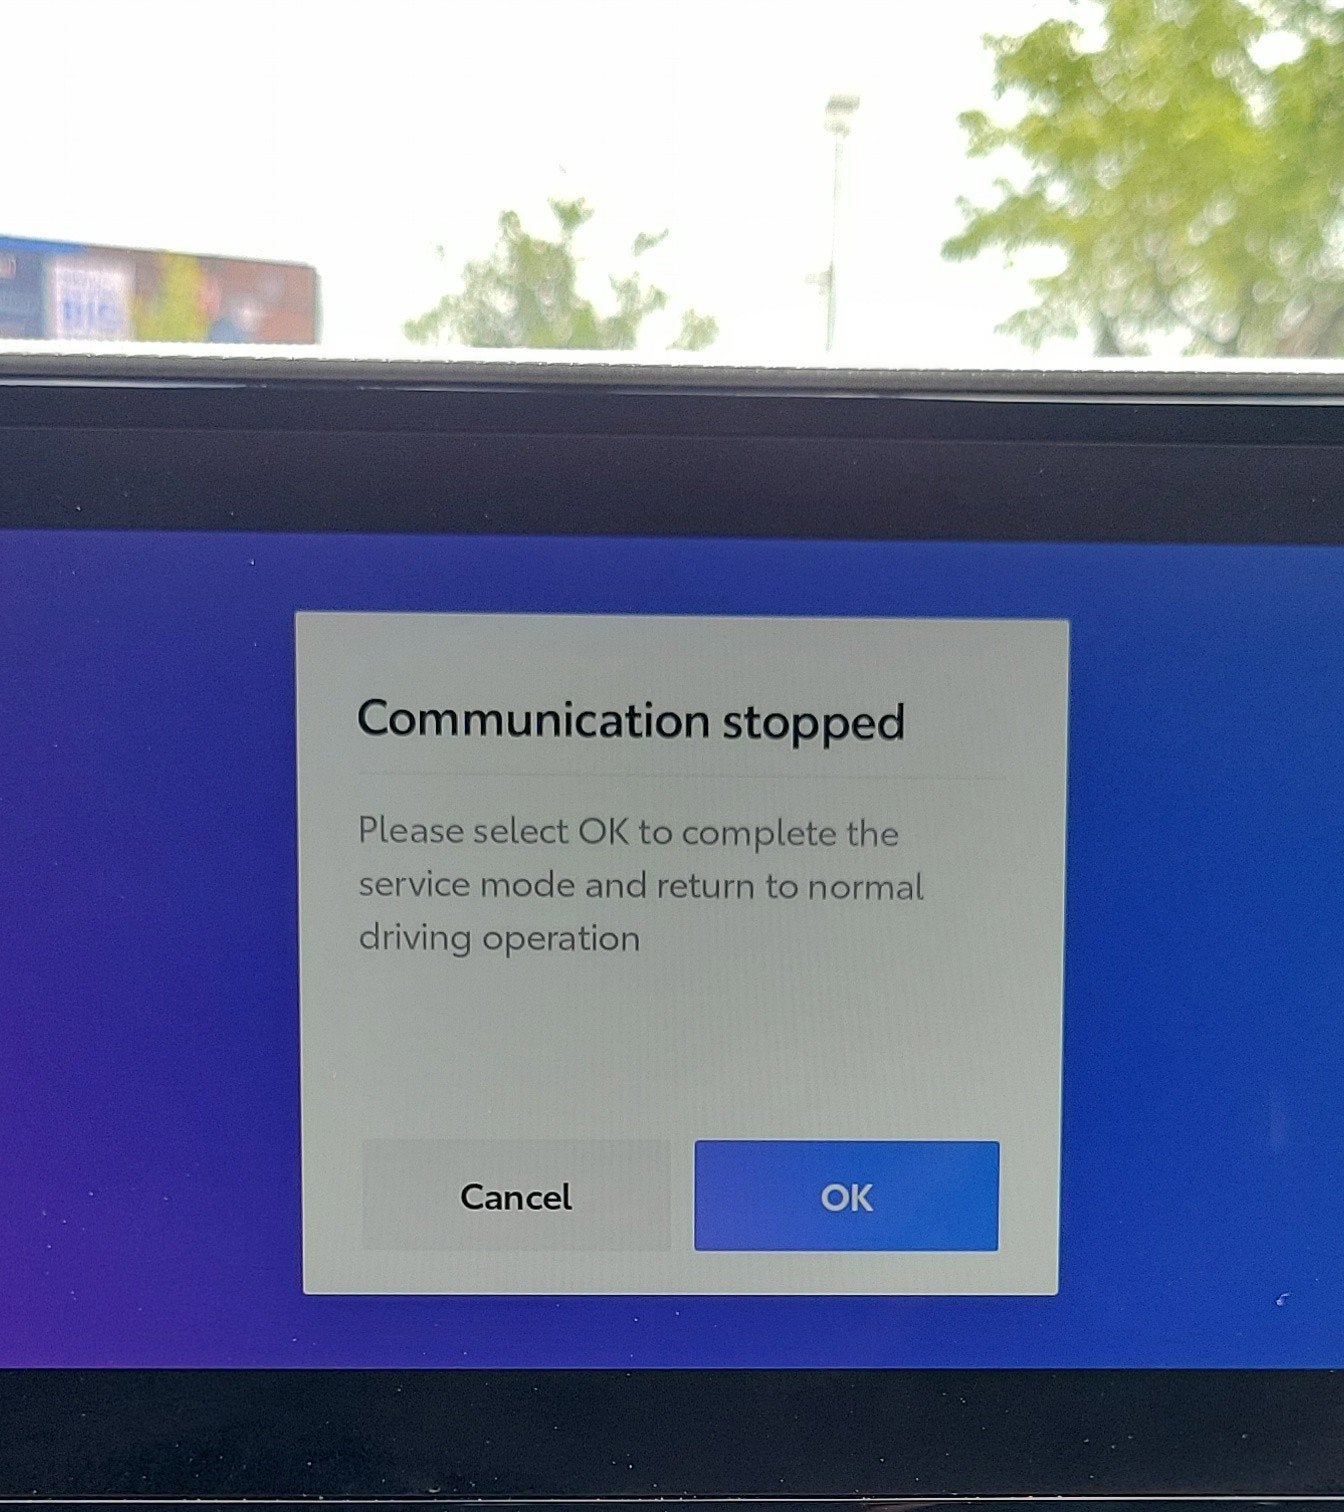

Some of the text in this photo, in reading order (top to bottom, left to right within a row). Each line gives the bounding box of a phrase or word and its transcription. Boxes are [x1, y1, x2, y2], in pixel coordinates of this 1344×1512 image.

[357, 698, 905, 750] Communication stopped
[358, 815, 900, 854] Please select OK to complete the
[358, 871, 925, 903] service mode and return to normal
[358, 923, 642, 959] driving operation
[460, 1183, 573, 1212] Cancel
[820, 1183, 875, 1213] OK
